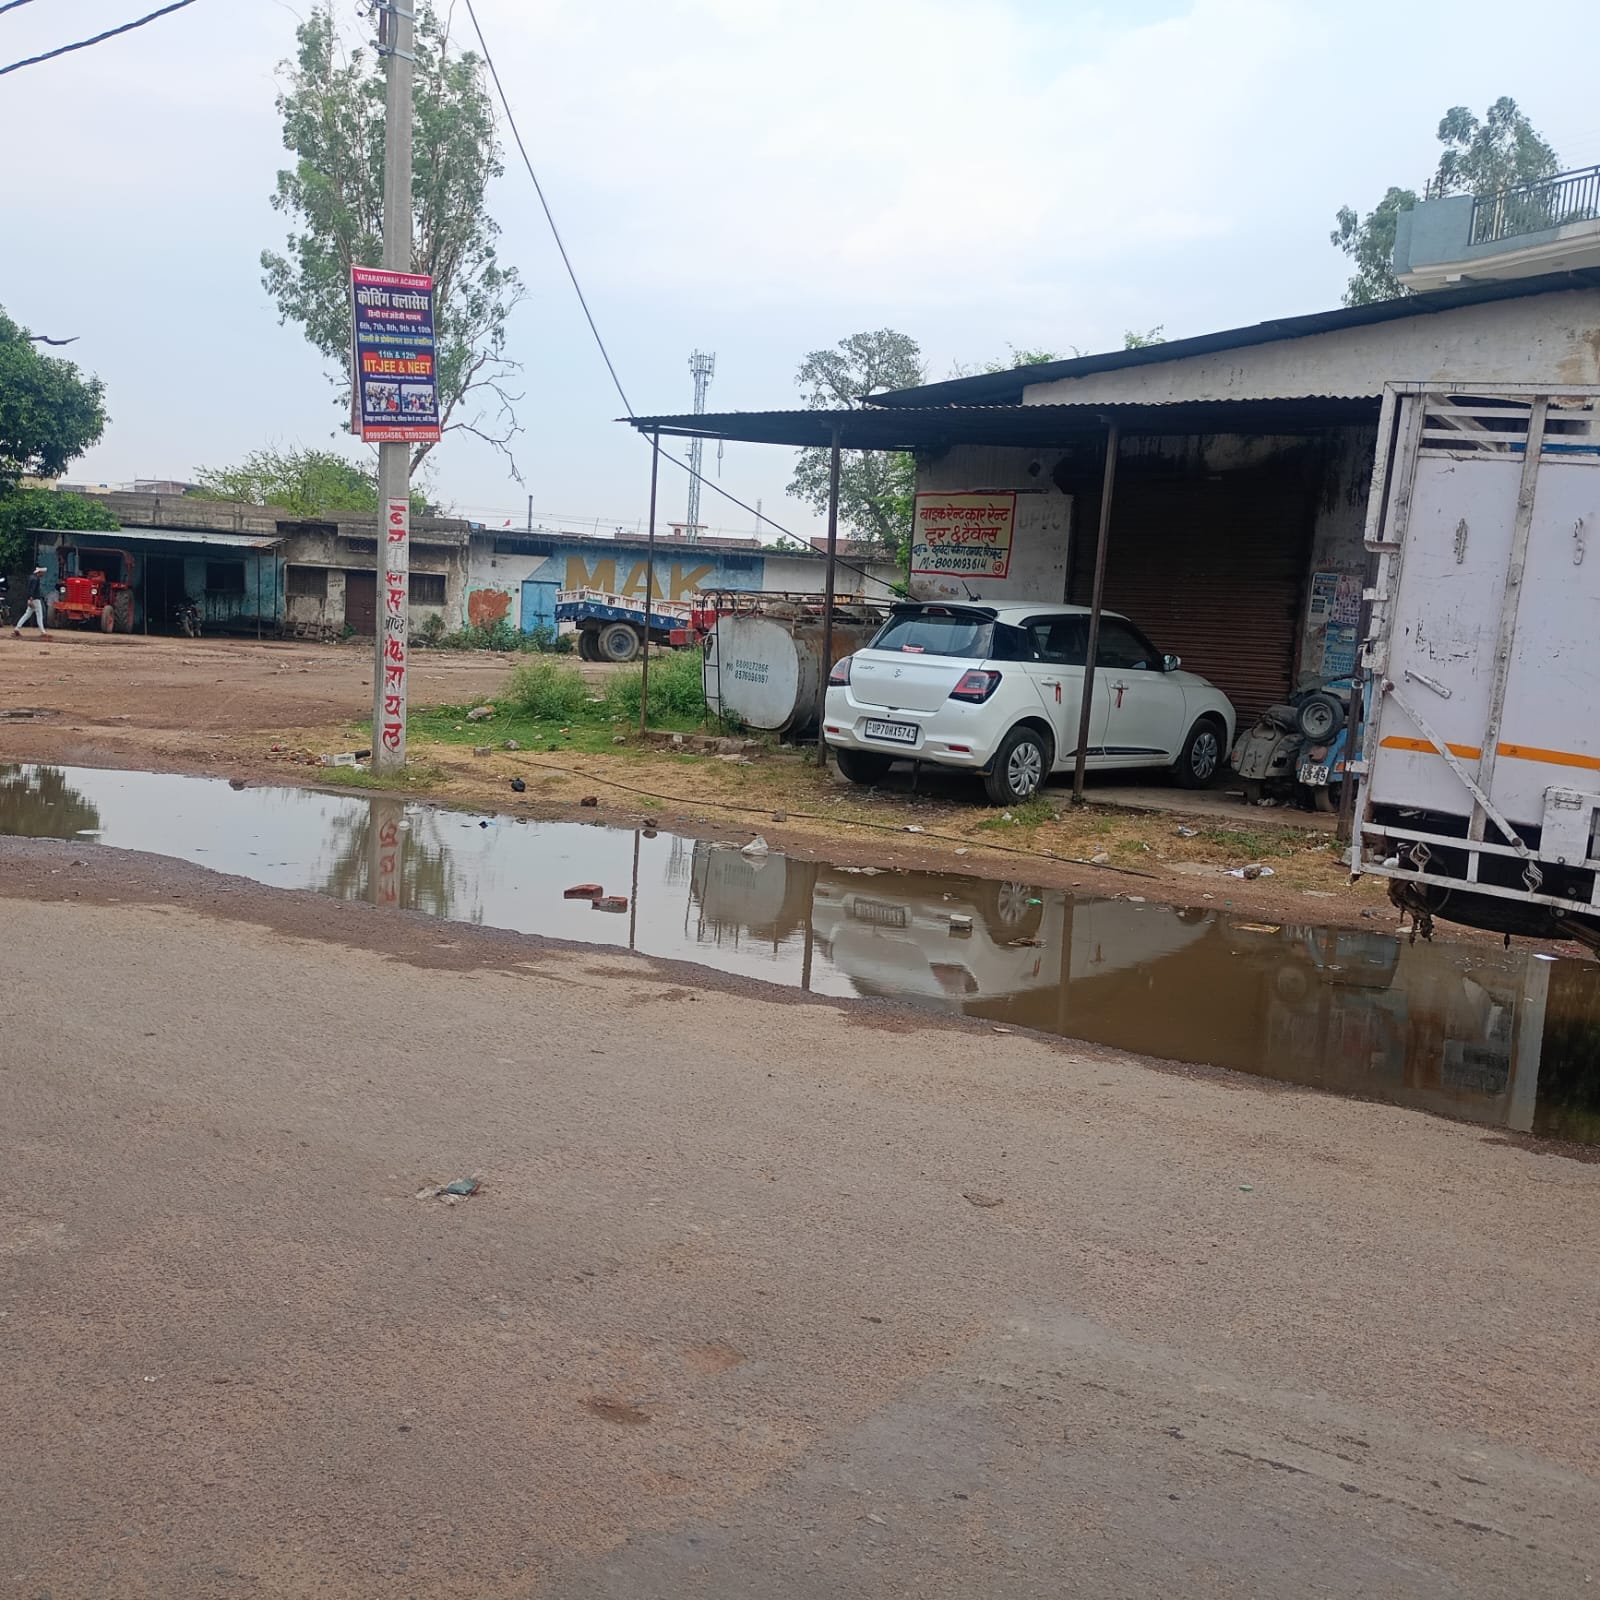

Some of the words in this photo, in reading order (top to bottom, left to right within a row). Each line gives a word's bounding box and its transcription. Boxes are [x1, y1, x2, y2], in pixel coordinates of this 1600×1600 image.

[400, 278, 428, 287] ACADEMY
[356, 286, 390, 307] कोचिंग
[391, 291, 429, 310] क्लासेस
[378, 350, 394, 359] 11th
[394, 351, 401, 359] &
[402, 351, 417, 360] 12th
[363, 359, 396, 373] IIT-JEE
[398, 361, 405, 373] &
[407, 361, 431, 375] NEET
[565, 556, 716, 601] MAK
